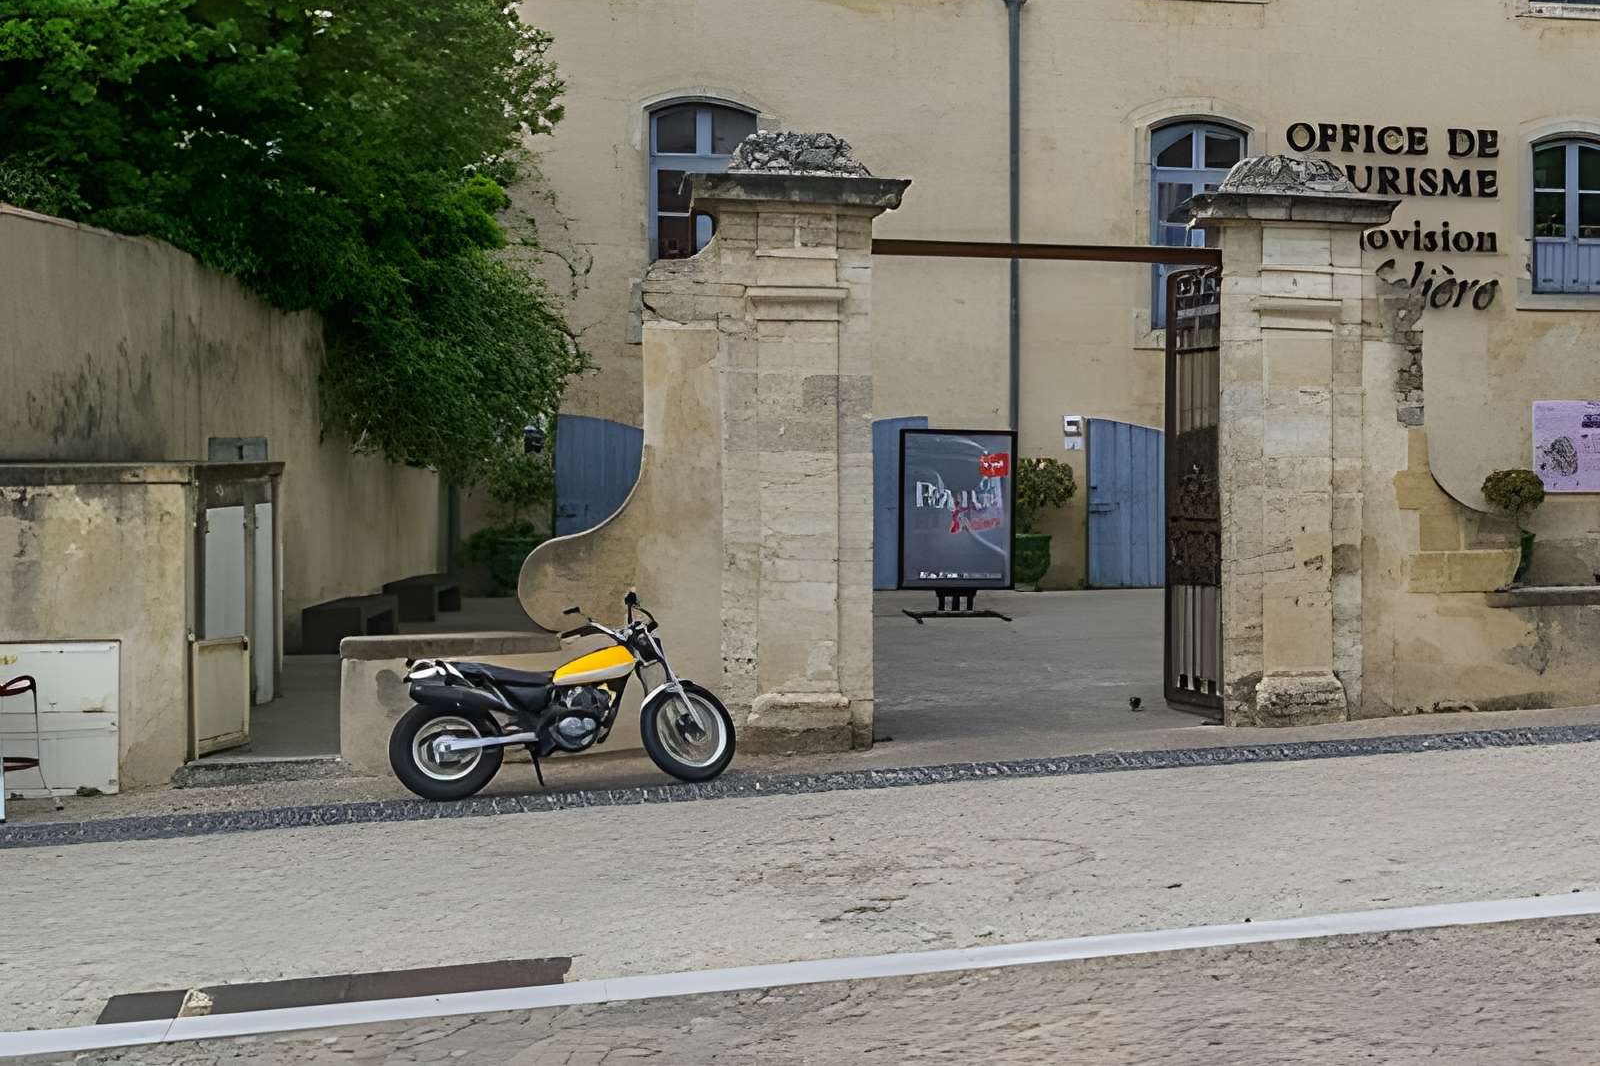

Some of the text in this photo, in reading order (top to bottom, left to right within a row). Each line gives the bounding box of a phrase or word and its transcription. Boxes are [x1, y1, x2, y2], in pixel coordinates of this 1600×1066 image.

[1286, 122, 1500, 159] OFFICE DE
[1345, 164, 1499, 198] URISME
[1359, 220, 1498, 253] ovision
